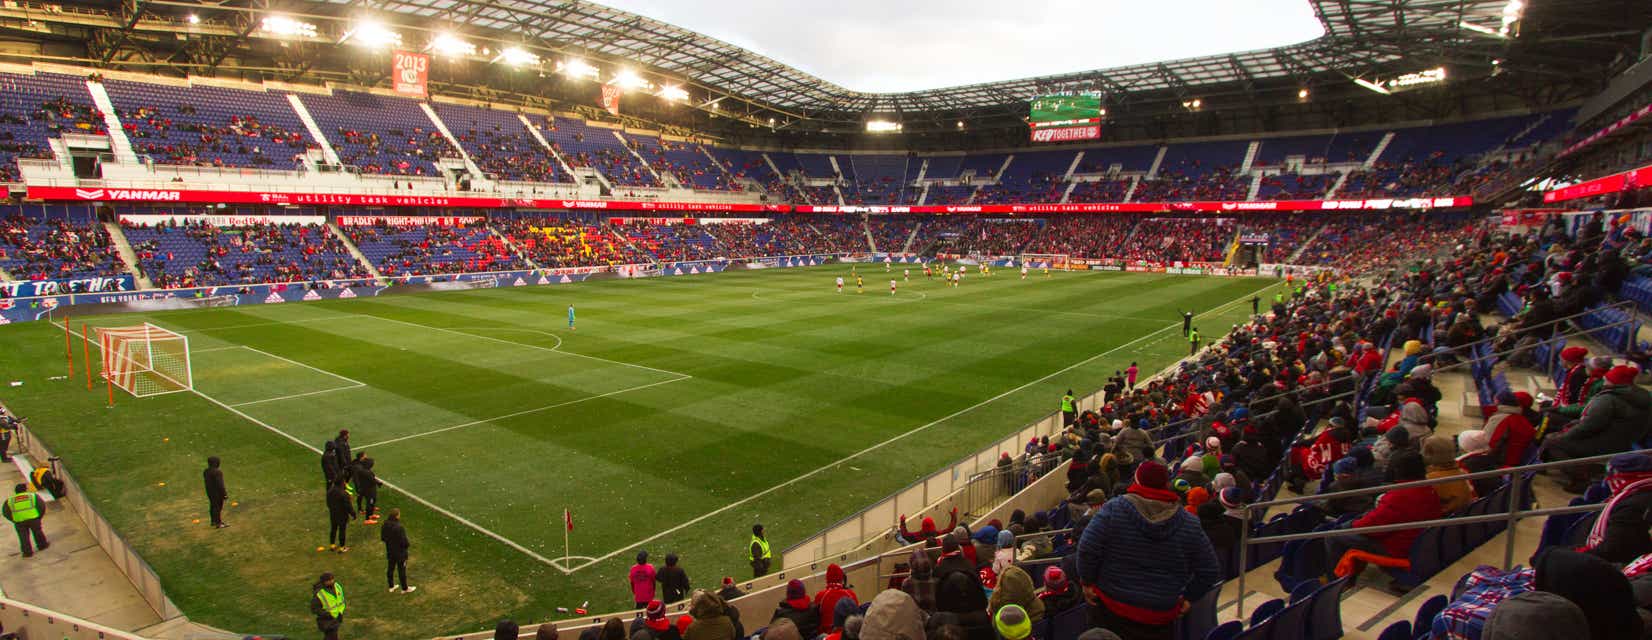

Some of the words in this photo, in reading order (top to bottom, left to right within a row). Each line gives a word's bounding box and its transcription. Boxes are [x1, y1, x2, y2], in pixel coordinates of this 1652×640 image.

[396, 54, 426, 72] 2013
[1053, 127, 1086, 139] TOGETHER
[108, 190, 180, 200] YANMAR
[297, 194, 351, 204] utility
[360, 195, 389, 204] task
[397, 195, 449, 205] vehicles
[343, 216, 376, 226] BRADLEY
